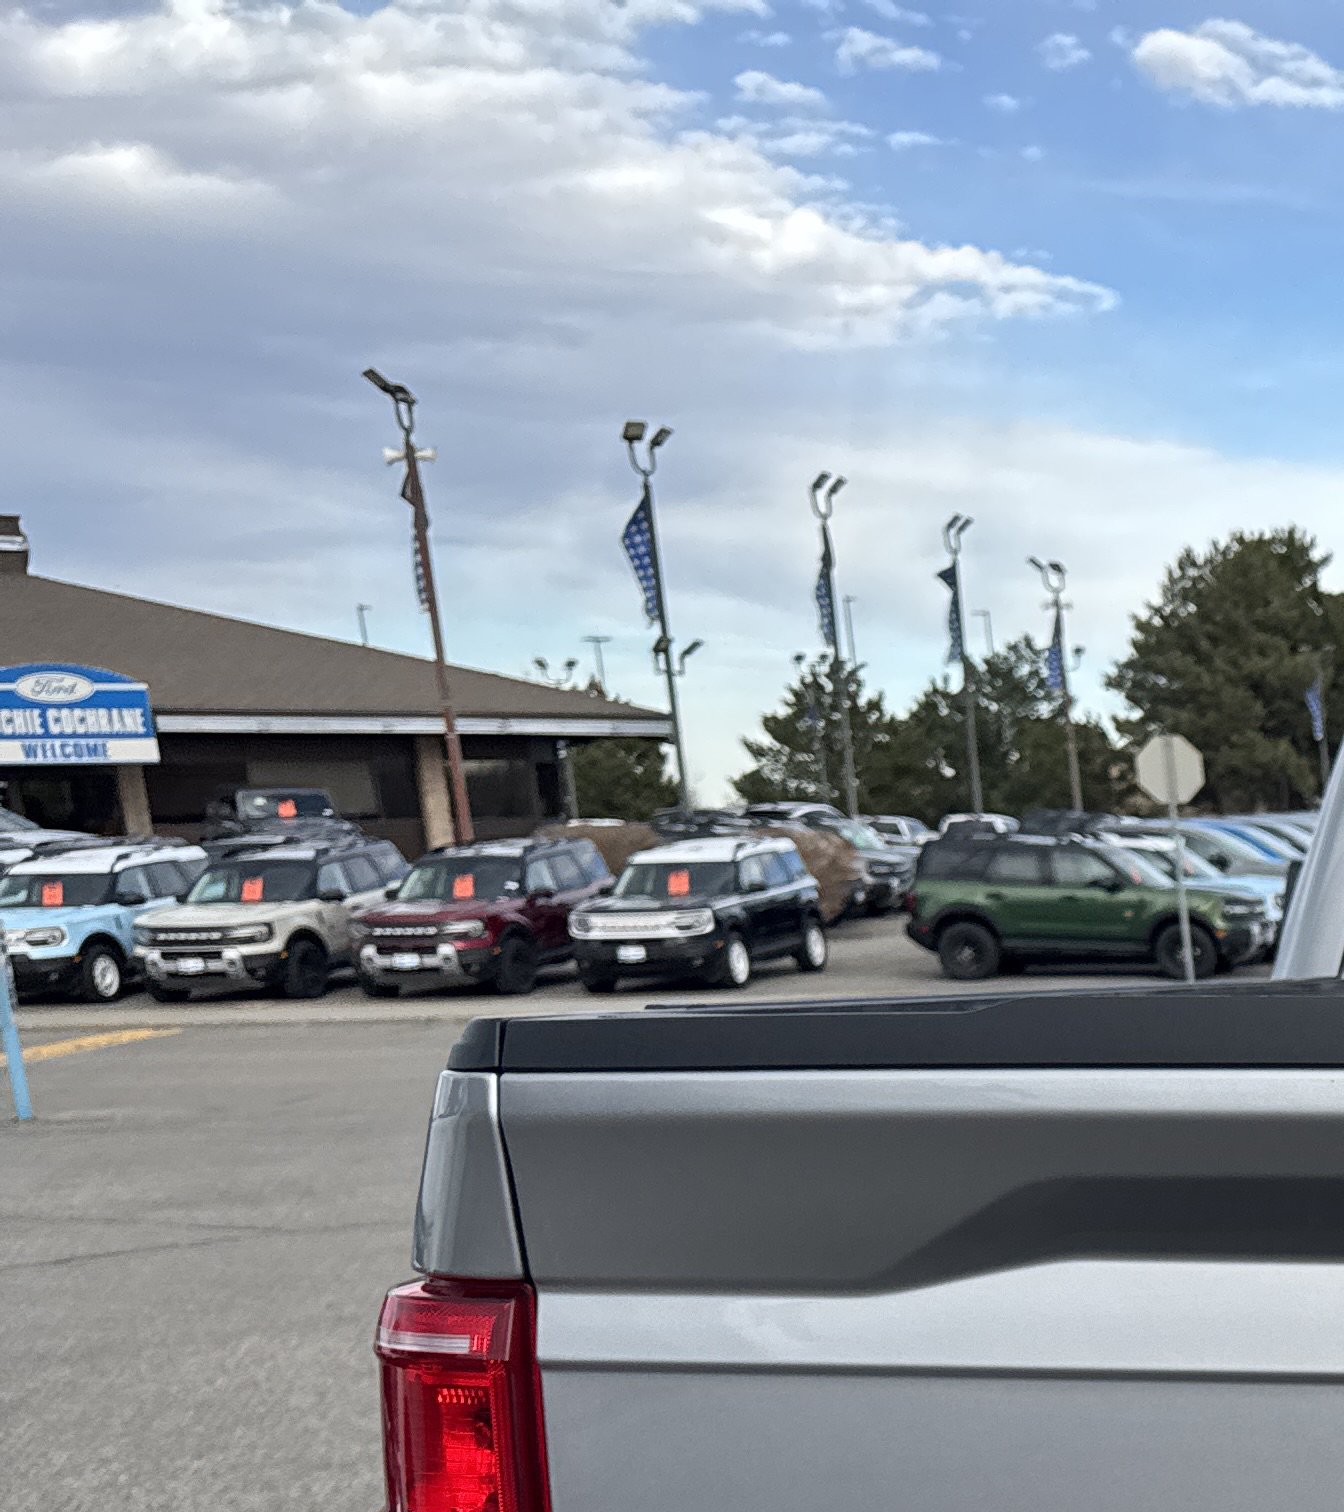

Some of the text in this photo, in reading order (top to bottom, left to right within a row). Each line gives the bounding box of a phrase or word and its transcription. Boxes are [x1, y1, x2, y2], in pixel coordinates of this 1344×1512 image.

[31, 676, 78, 697] Ford
[46, 708, 147, 735] COCHRANE
[21, 743, 109, 759] WELCOME
